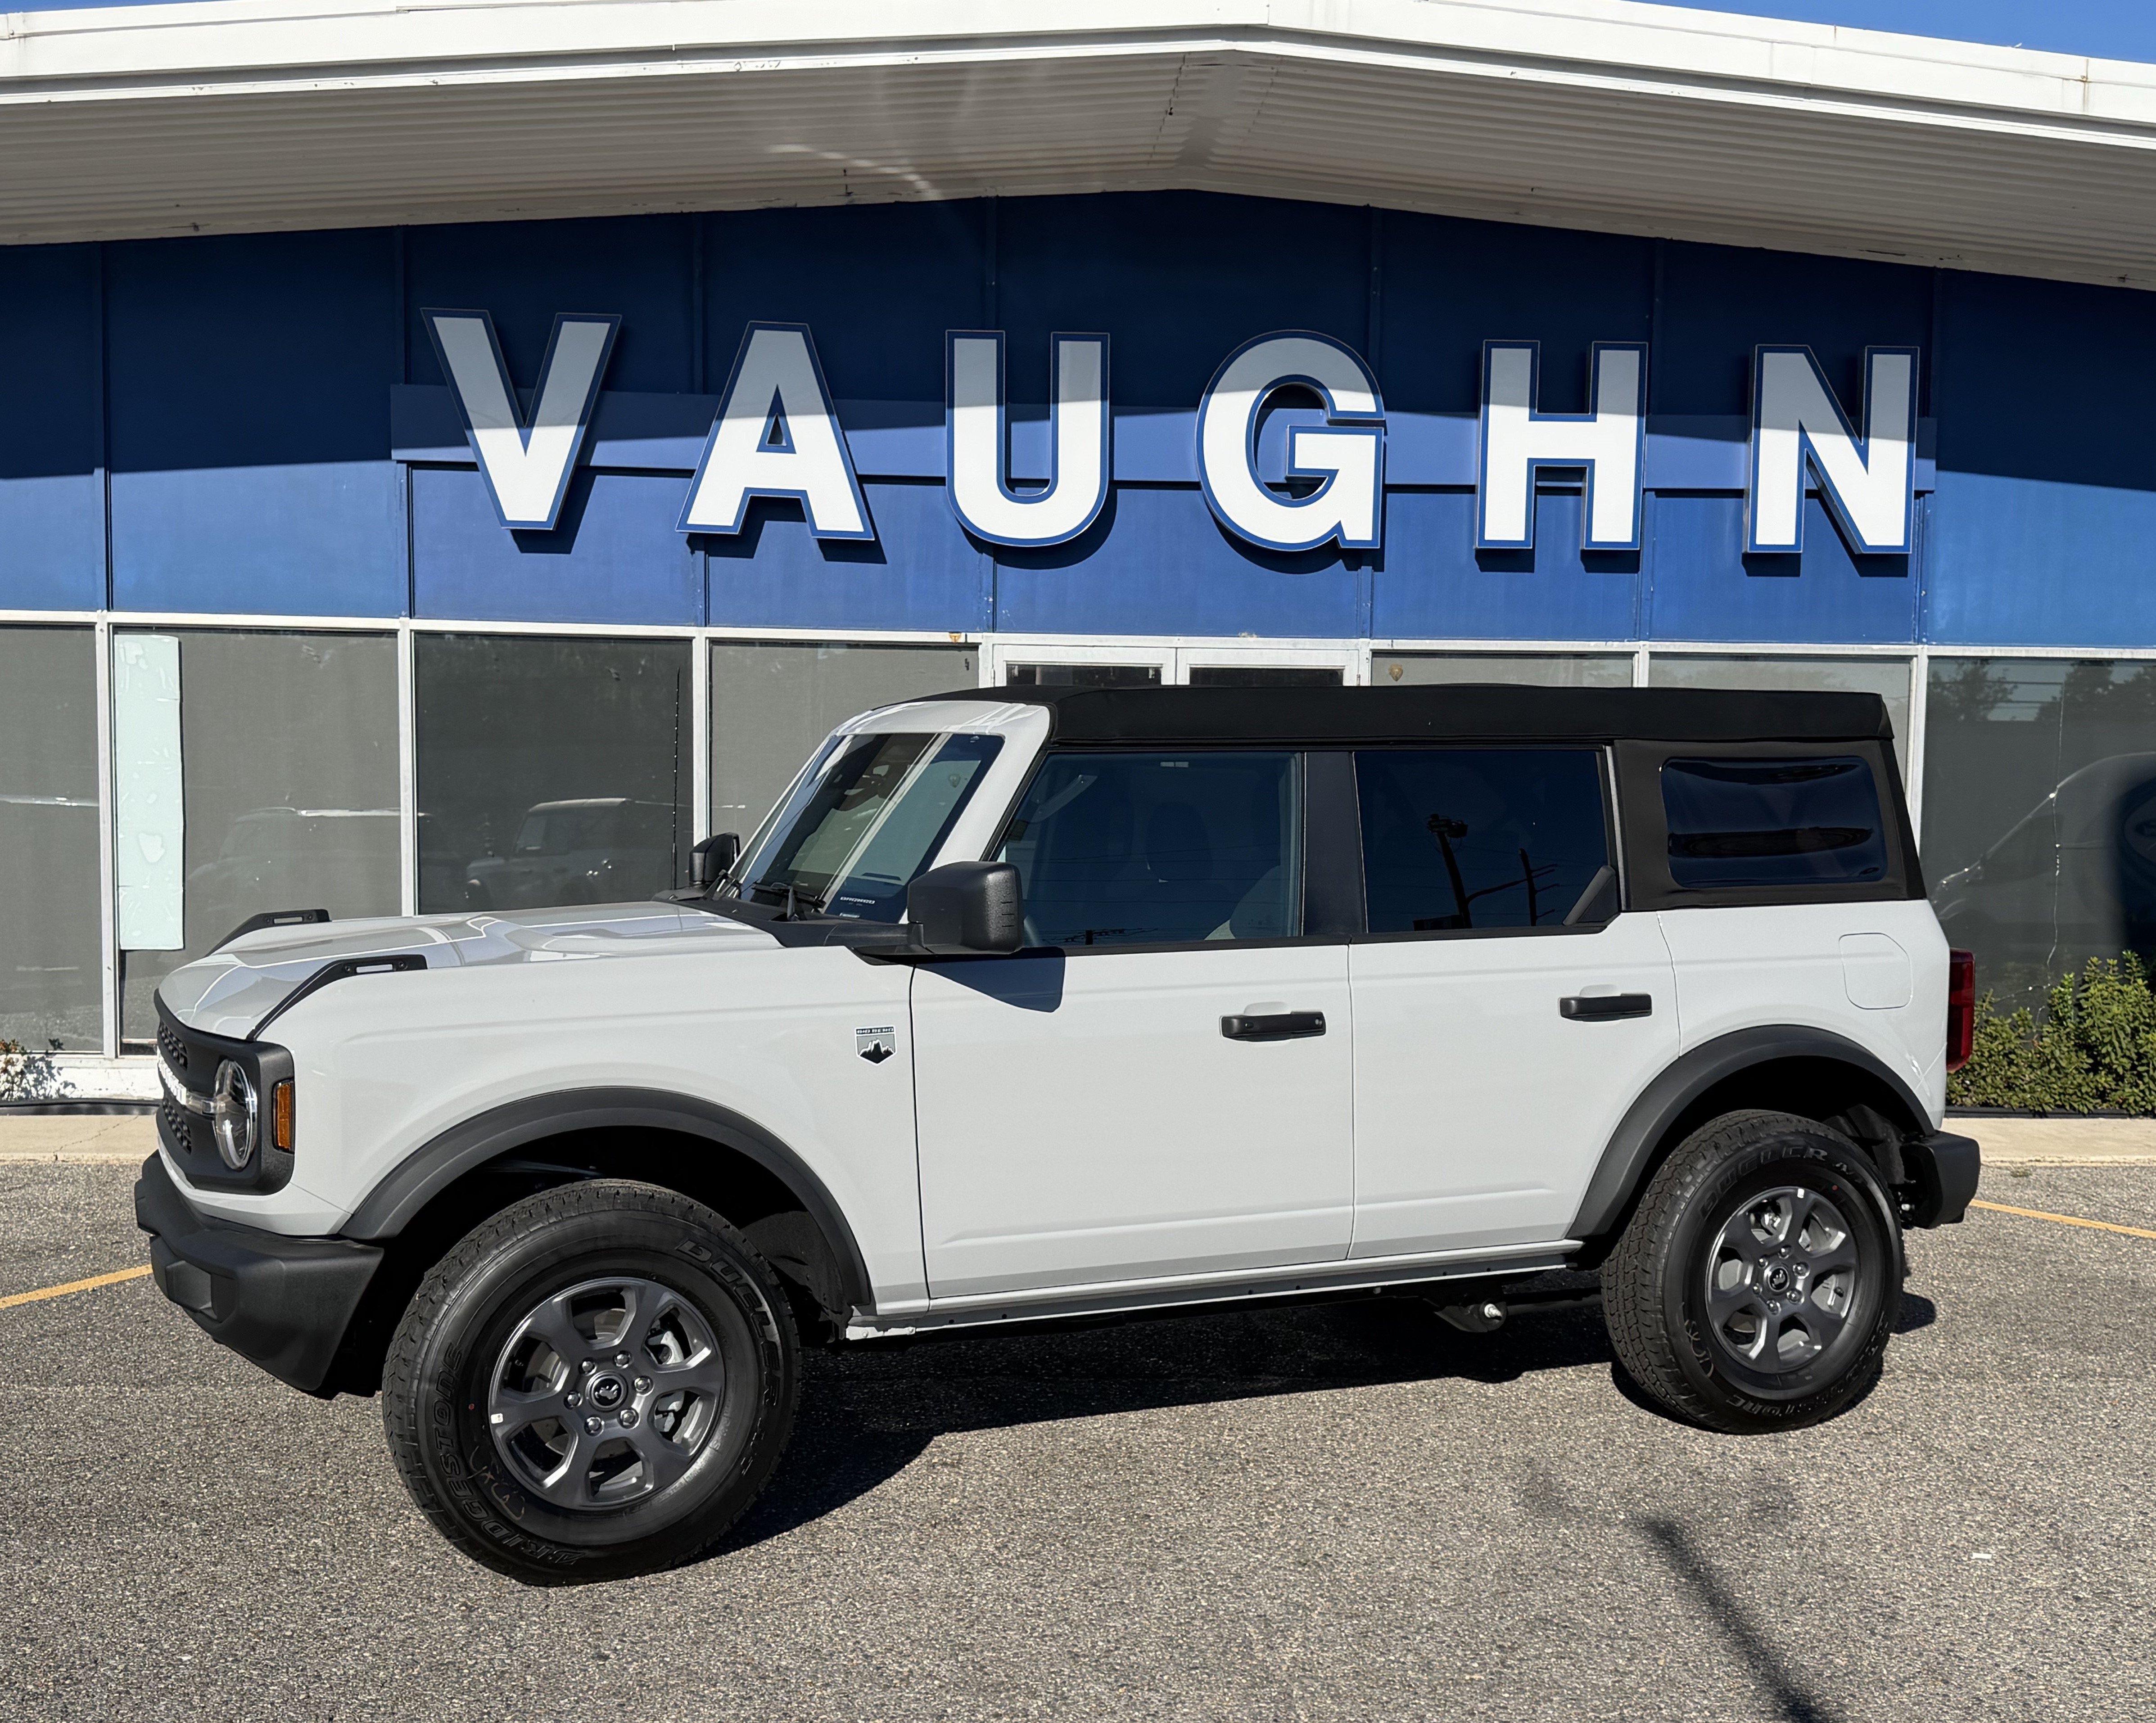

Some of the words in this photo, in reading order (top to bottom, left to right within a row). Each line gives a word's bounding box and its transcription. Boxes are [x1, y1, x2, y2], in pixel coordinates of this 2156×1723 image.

[420, 307, 1920, 554] VAUGHN
[676, 1238, 782, 1407] DUELER
[434, 1343, 587, 1565] BRIDGESTONE
